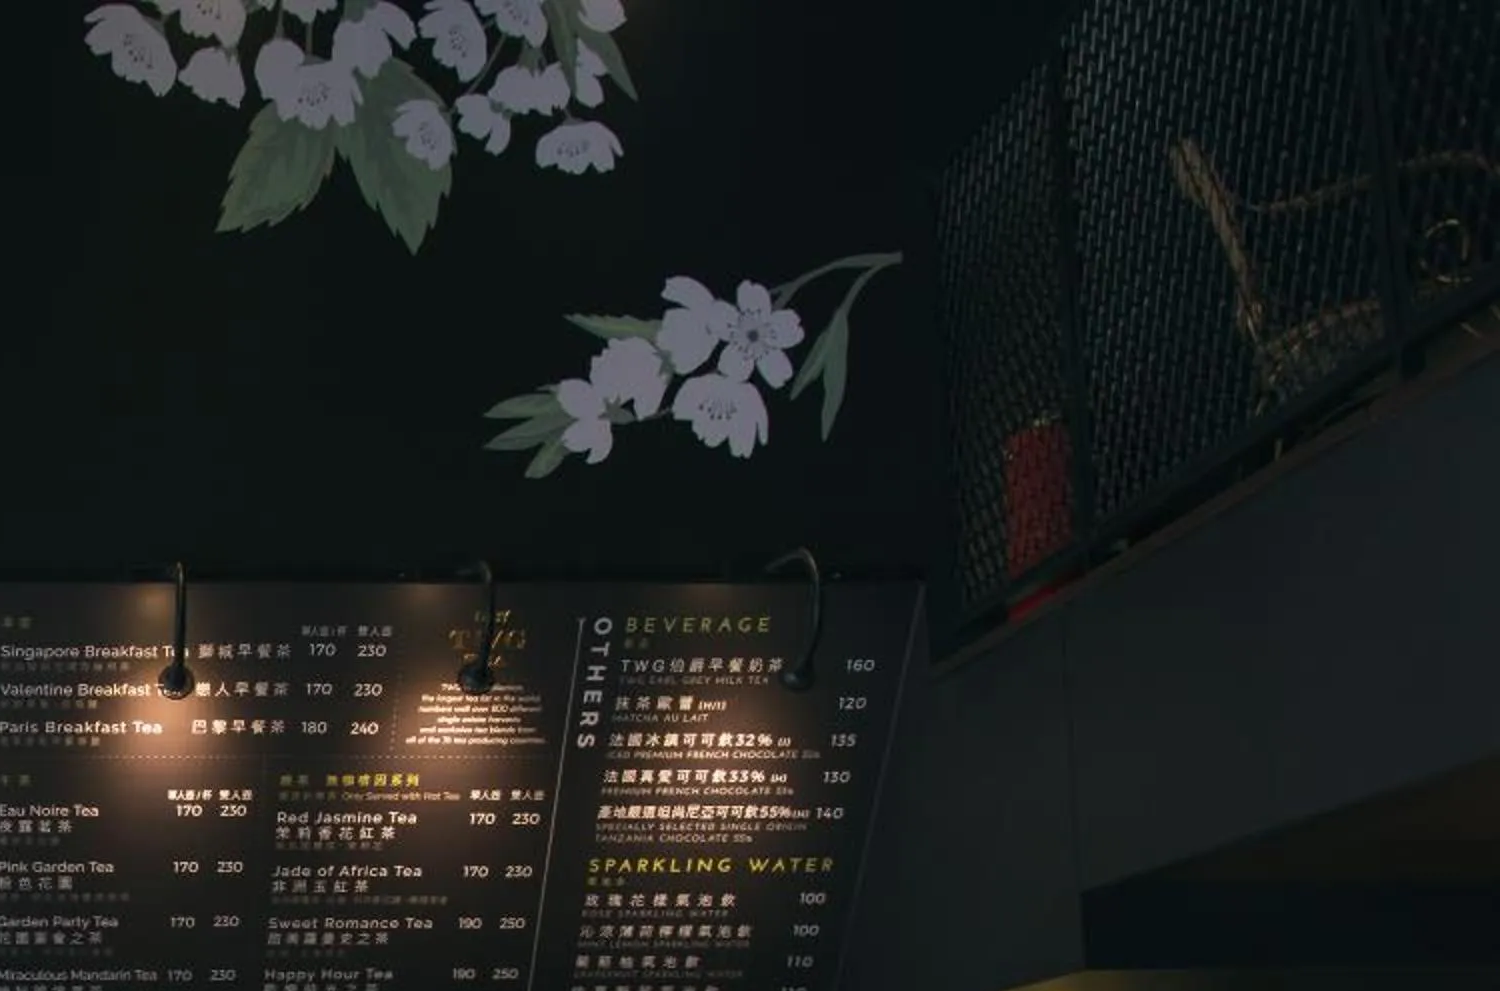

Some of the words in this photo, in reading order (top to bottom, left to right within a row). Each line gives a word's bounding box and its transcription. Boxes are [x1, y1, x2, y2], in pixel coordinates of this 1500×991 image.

[626, 617, 771, 633] BEVERAGE
[0, 645, 80, 661] Singapore
[85, 645, 157, 657] Breakfast
[310, 644, 337, 656] 170
[357, 645, 386, 656] 230
[847, 660, 875, 672] 160
[577, 617, 613, 749] OTHERS
[0, 684, 73, 697] Valentine
[77, 684, 150, 697] Breakfast
[307, 683, 332, 695] 170
[354, 684, 382, 696] 230
[839, 697, 866, 710] 120
[0, 722, 38, 733] Paris
[45, 721, 126, 733] Breakfast
[132, 721, 162, 733] Tea
[301, 722, 327, 734] 180
[350, 723, 378, 735] 240
[831, 735, 857, 747] 135
[823, 771, 850, 783] 130
[30, 805, 68, 817] Noire
[74, 804, 99, 817] Tea
[176, 805, 202, 817] 170
[220, 805, 246, 817] 230
[816, 808, 843, 819] 140
[277, 812, 308, 824] Red
[315, 812, 383, 824] Jasmine
[388, 812, 417, 824] Tea
[470, 813, 495, 825] 170
[512, 814, 540, 825] 230
[32, 862, 85, 873] Garden
[90, 862, 114, 873] Tea
[173, 862, 198, 873] 170
[217, 862, 243, 873] 230
[589, 858, 732, 873] SPARKLING
[749, 858, 834, 873] WATER
[272, 866, 312, 877] Jade
[317, 866, 334, 877] of
[339, 866, 388, 877] Africa
[394, 866, 422, 877] Tea
[463, 866, 488, 878] 170
[505, 866, 532, 878] 230
[800, 892, 826, 904] 100
[53, 917, 90, 929] Party
[94, 916, 118, 928] Tea
[171, 917, 195, 928] 170
[213, 917, 239, 927] 230
[268, 918, 318, 929] Sweet
[324, 918, 399, 929] Romance
[405, 918, 433, 929] Tea
[459, 918, 482, 929] 190
[499, 917, 525, 929] 250
[793, 925, 819, 936] 100
[787, 956, 813, 968] 110
[71, 970, 131, 981] Mandarin
[135, 971, 157, 981] Tea
[168, 970, 192, 981] 170
[210, 970, 236, 981] 230
[264, 969, 315, 982] Happy
[321, 969, 359, 979] Hour
[365, 969, 394, 979] Tea
[453, 969, 475, 980] 190
[492, 968, 519, 980] 250
